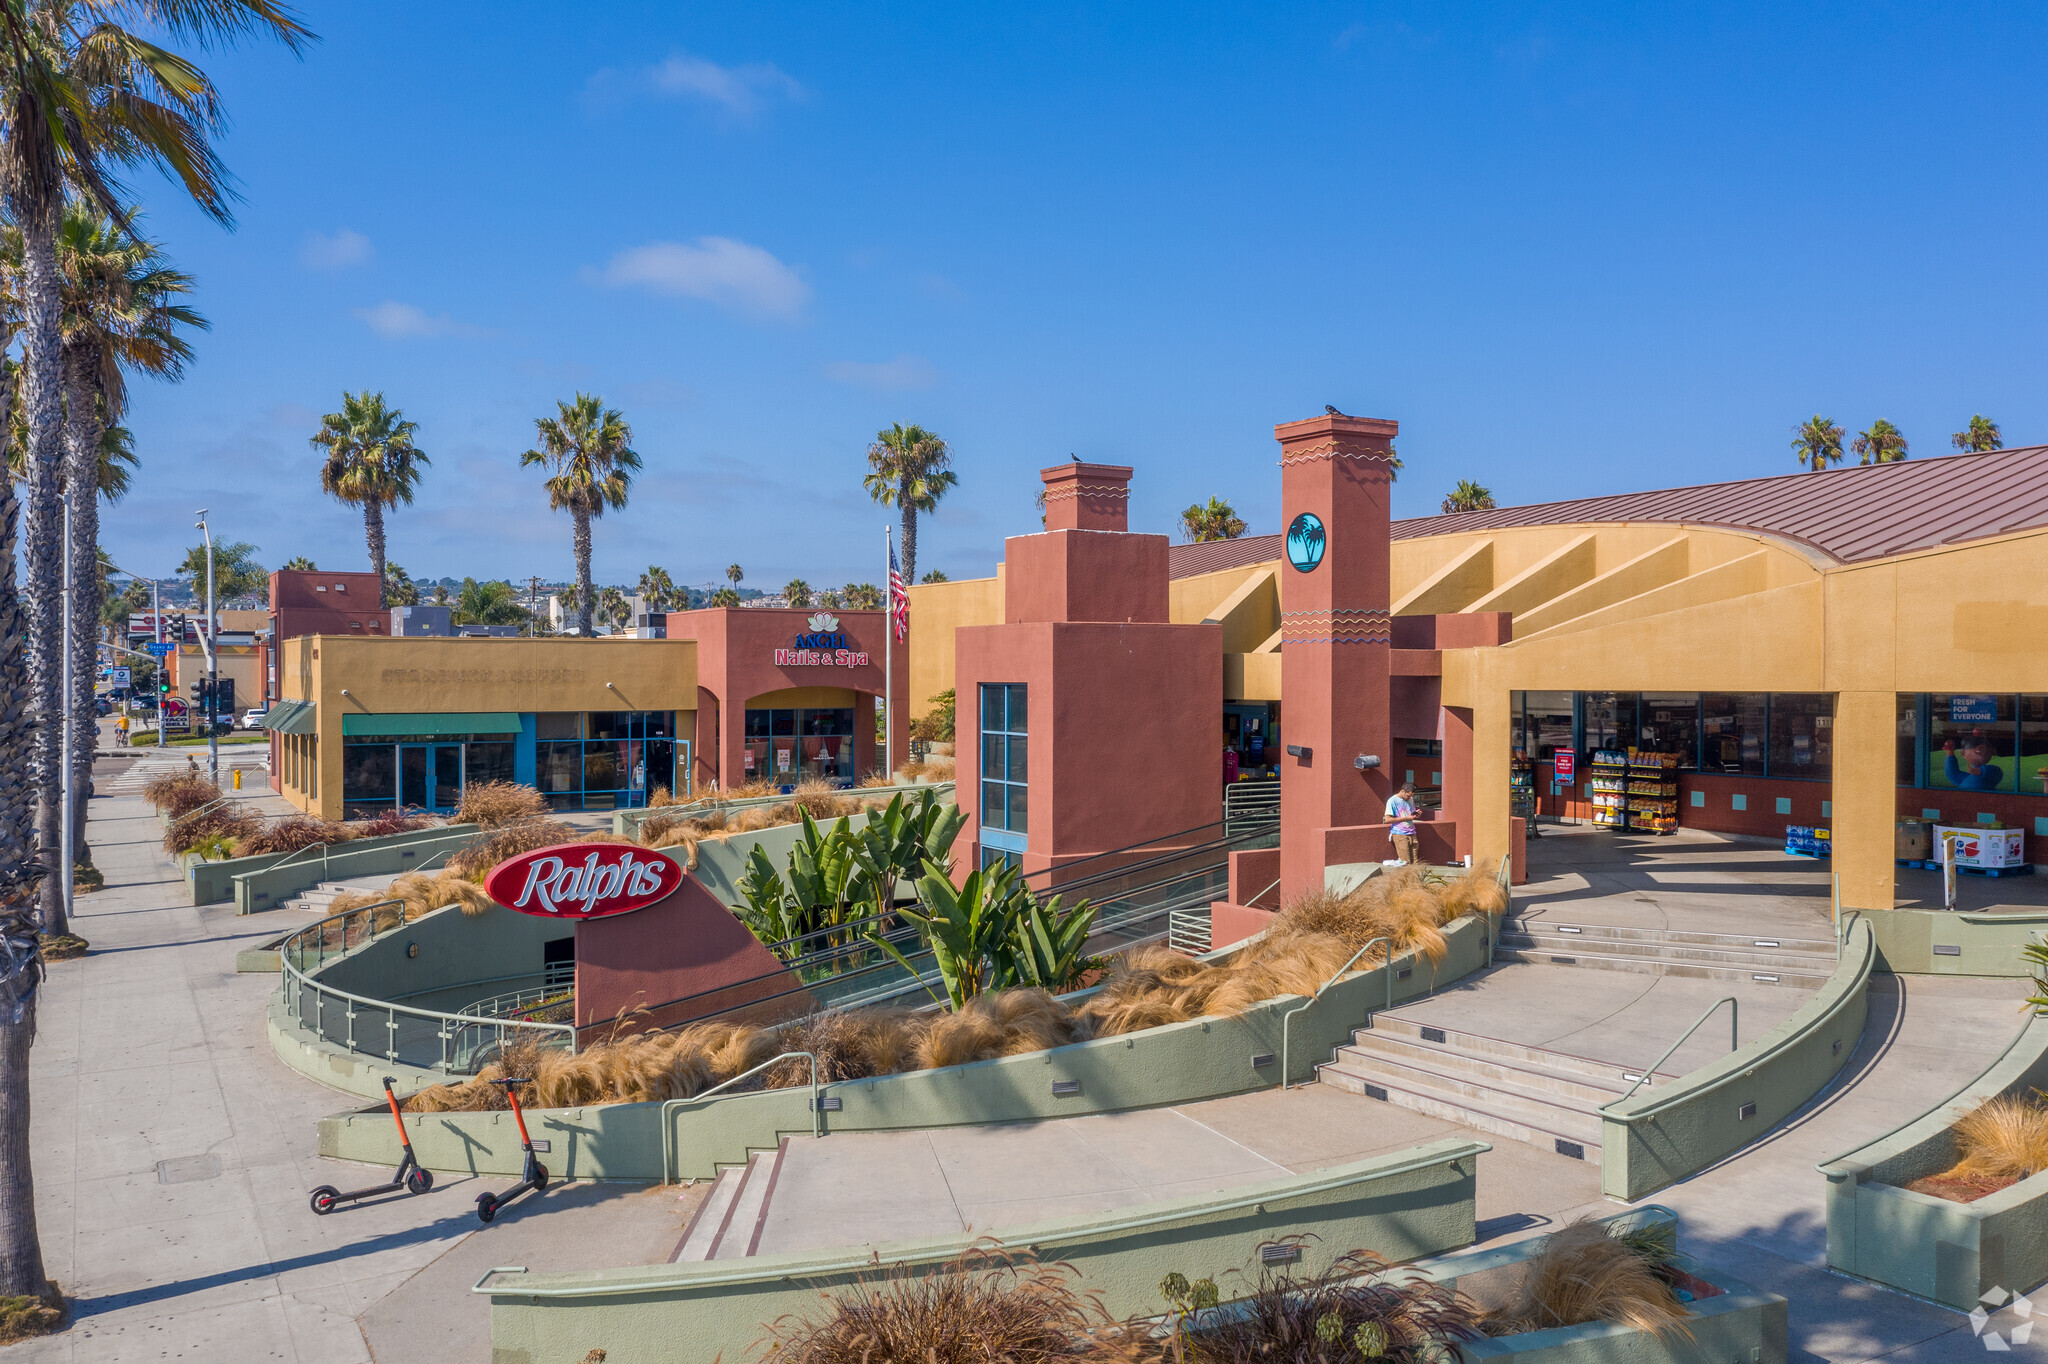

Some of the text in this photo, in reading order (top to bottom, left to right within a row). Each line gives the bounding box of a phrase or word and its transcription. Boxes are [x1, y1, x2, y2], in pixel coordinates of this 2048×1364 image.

[794, 633, 850, 649] ANGEL
[775, 649, 869, 668] Nails & Spa
[513, 851, 666, 913] Ralphs
